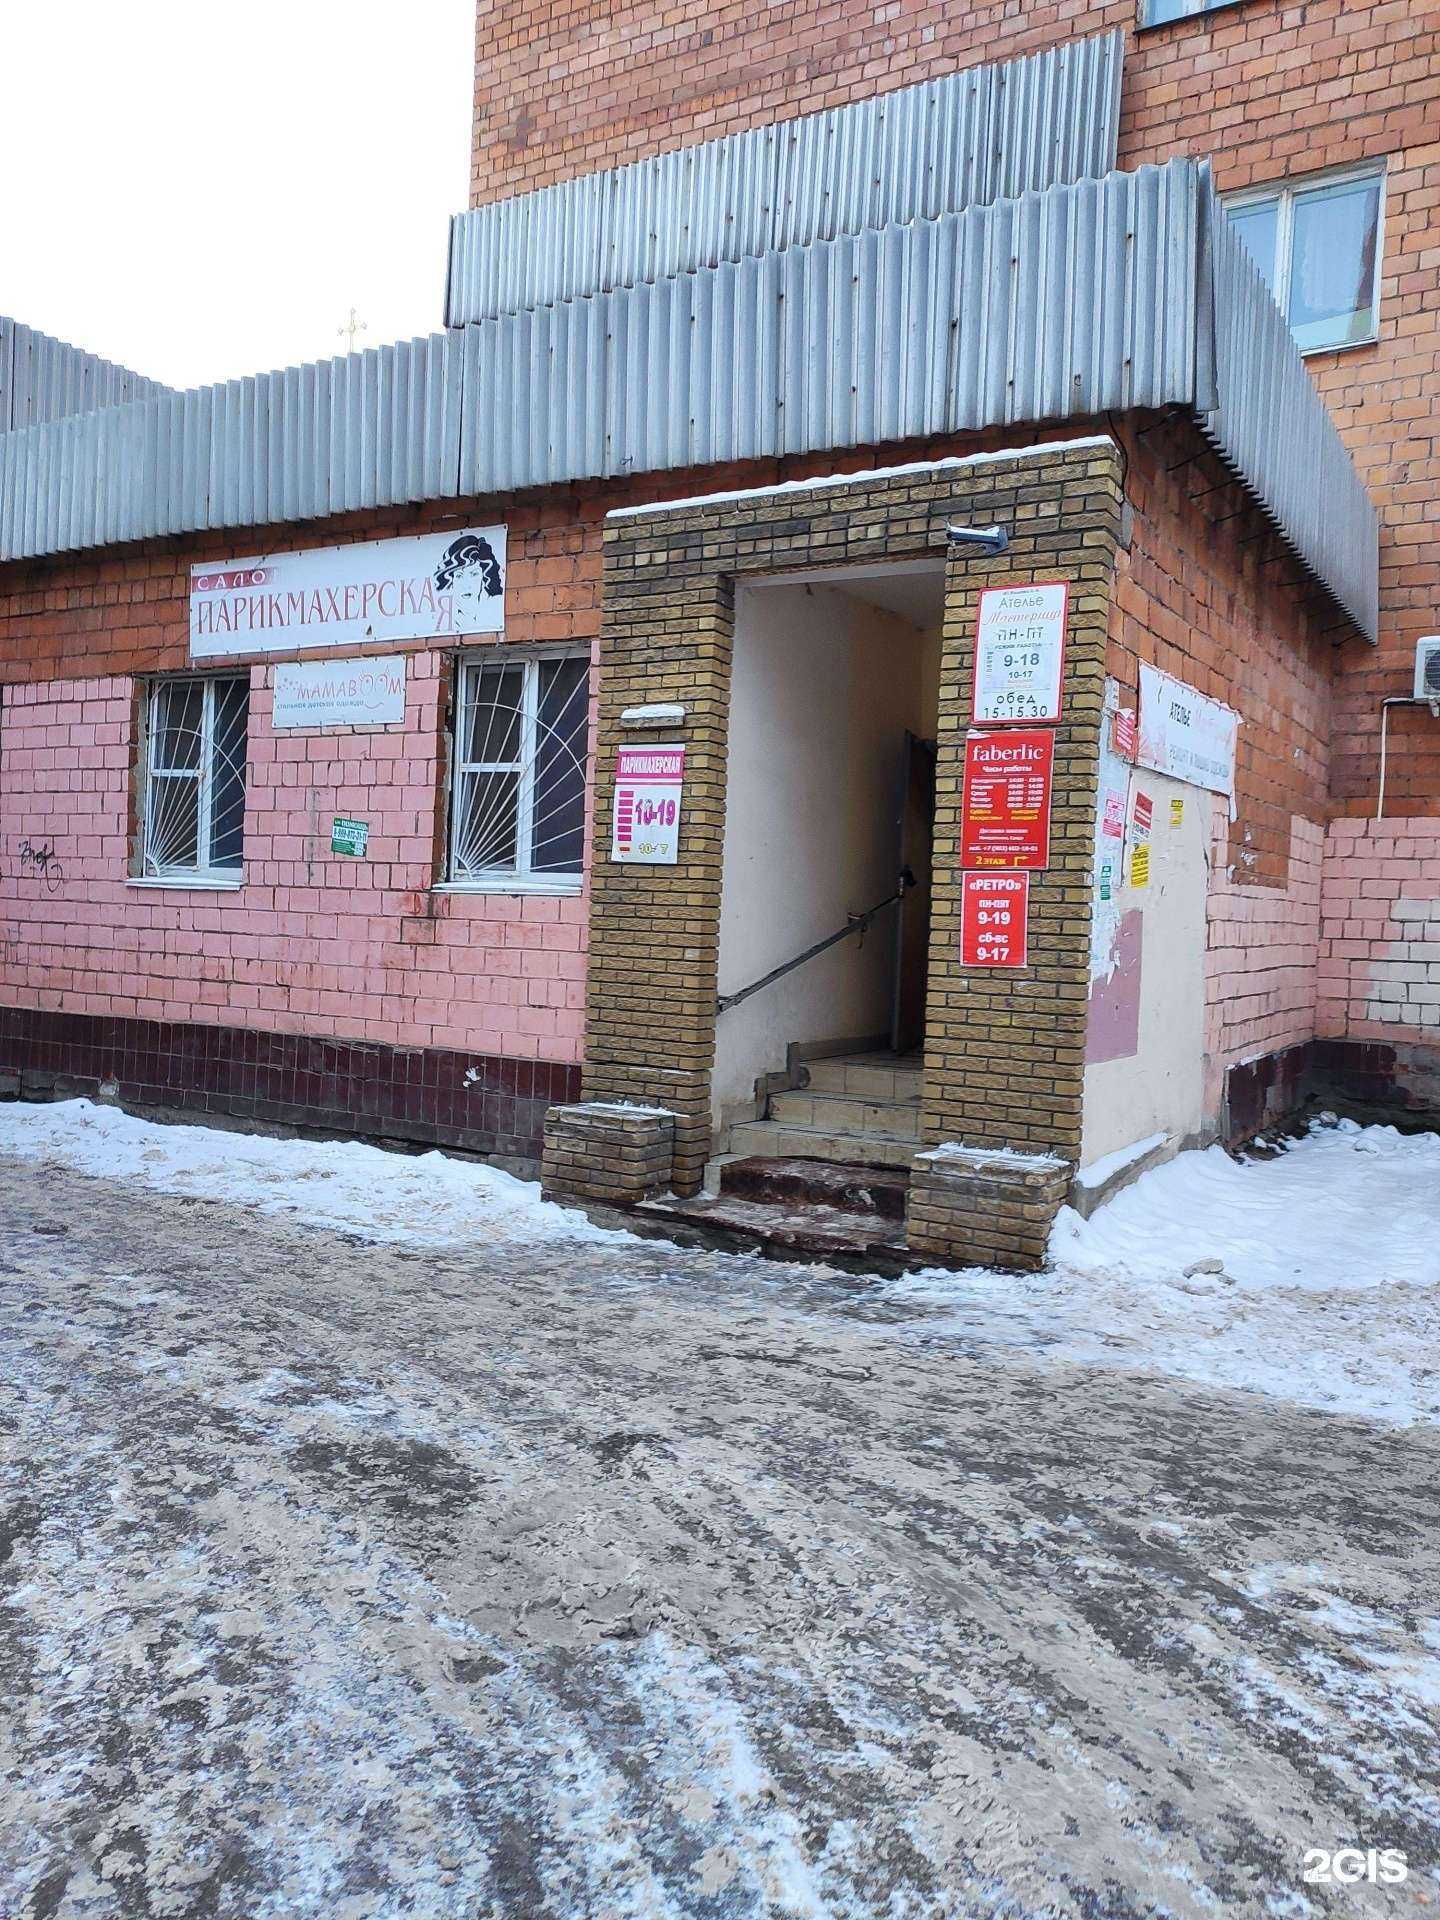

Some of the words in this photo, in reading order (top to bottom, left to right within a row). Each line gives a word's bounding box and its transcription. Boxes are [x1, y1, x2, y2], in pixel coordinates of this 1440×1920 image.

[198, 576, 453, 634] ПАРИКМАХЕРСКАЯ
[999, 596, 1044, 609] Ателье
[1004, 653, 1040, 667] 9-18
[1008, 671, 1033, 679] 10-17
[997, 692, 1036, 704] обед
[984, 705, 1048, 719] 15-15.30
[973, 744, 1044, 761] faberlic
[1003, 765, 1033, 773] работы
[976, 856, 982, 865] 2
[969, 879, 1022, 891] «РЕТРО»
[977, 911, 1011, 925] 9-19
[977, 947, 1010, 961] 9-17
